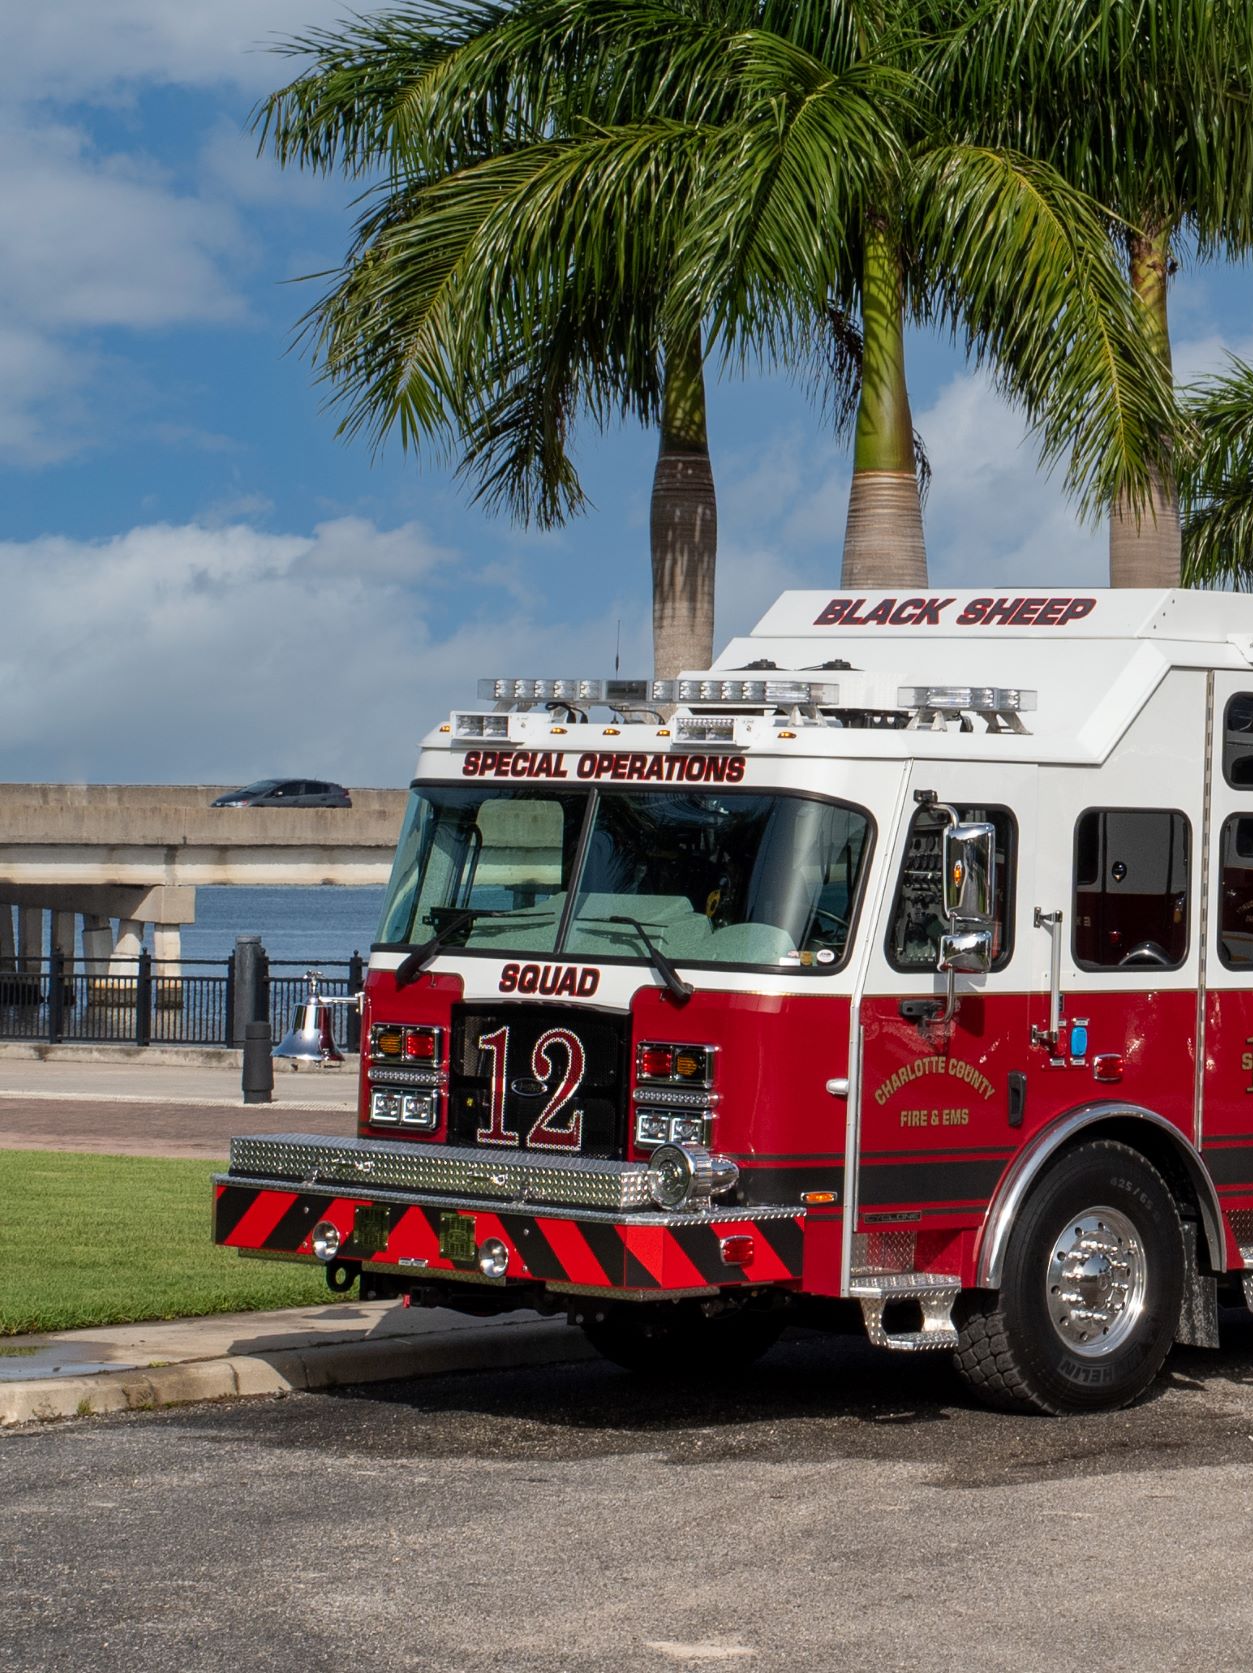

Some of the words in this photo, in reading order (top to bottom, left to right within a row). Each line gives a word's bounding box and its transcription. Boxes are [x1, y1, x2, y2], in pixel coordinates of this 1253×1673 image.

[813, 599, 956, 625] BLACK
[956, 598, 1097, 626] SHEEP
[462, 751, 568, 778] SPECIAL
[576, 752, 747, 783] OPERATIONS
[499, 963, 601, 998] SQUAD
[477, 1026, 586, 1150] 12
[874, 1055, 948, 1106] CHARLOTTE
[949, 1057, 996, 1100] COUNTY
[900, 1109, 928, 1127] FIRE
[930, 1110, 939, 1126] &
[942, 1108, 970, 1126] EMS
